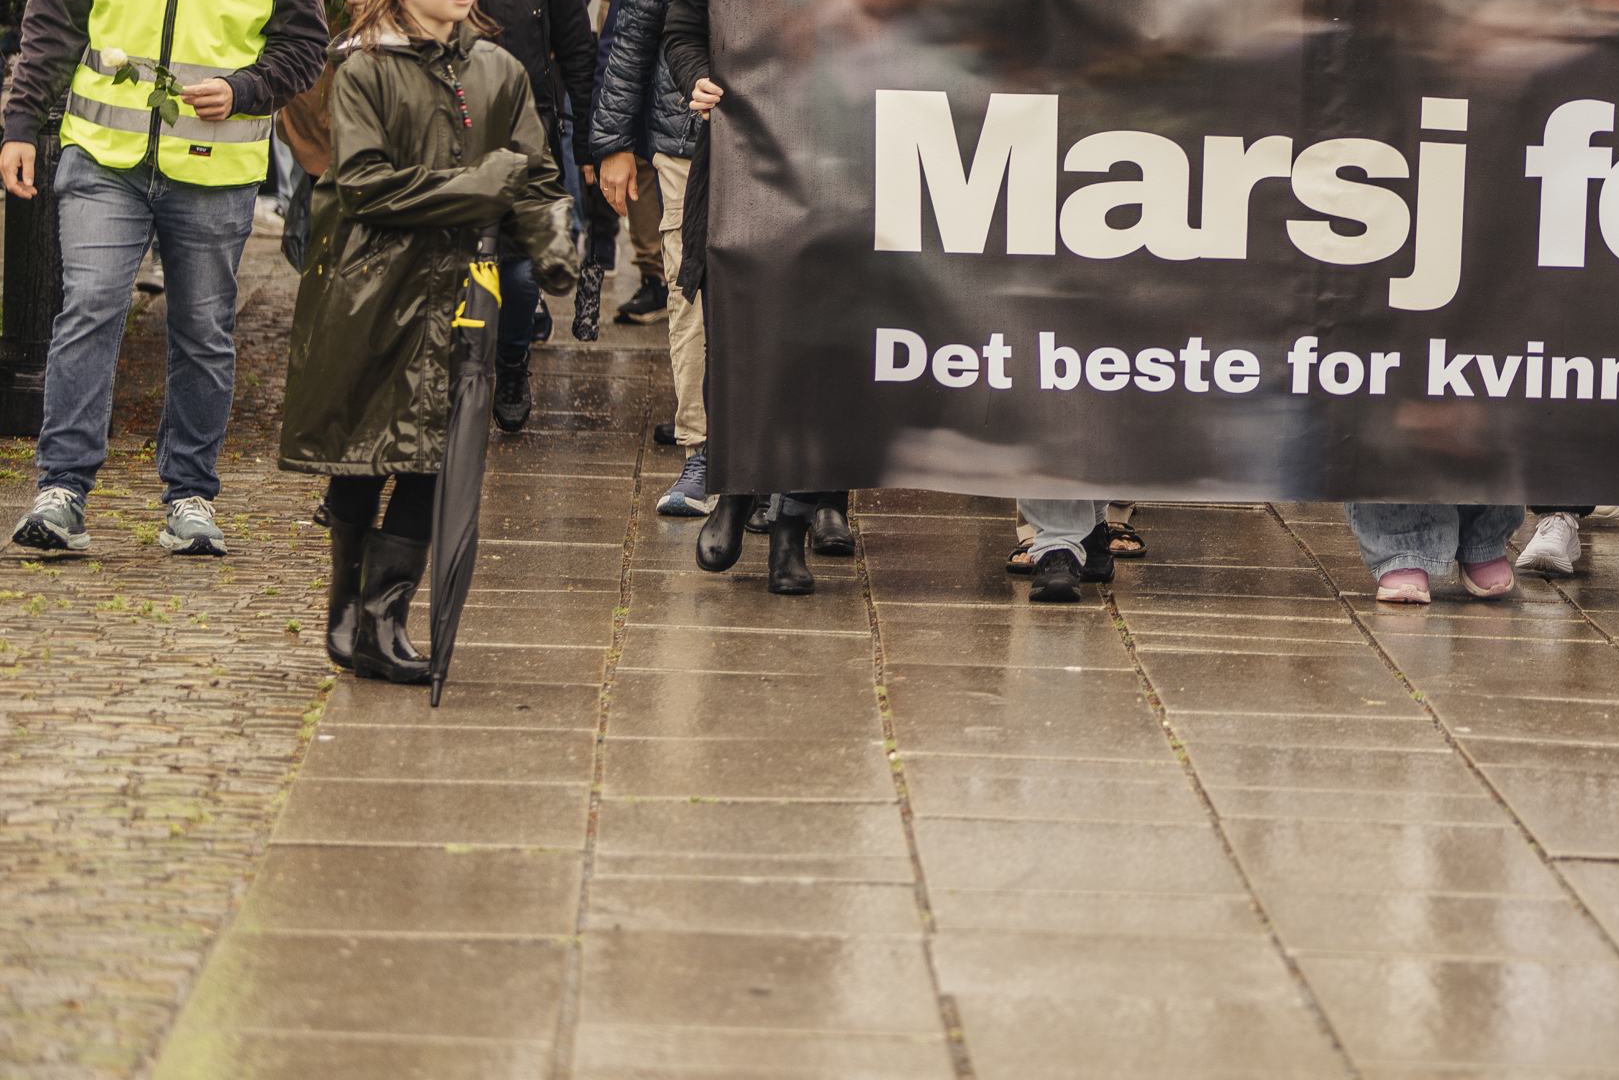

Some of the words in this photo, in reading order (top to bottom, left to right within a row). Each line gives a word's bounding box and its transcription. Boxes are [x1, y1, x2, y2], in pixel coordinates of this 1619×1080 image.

[874, 88, 1469, 311] Marsj
[874, 327, 1013, 390] Det
[1038, 331, 1261, 393] beste
[1287, 336, 1401, 395] for
